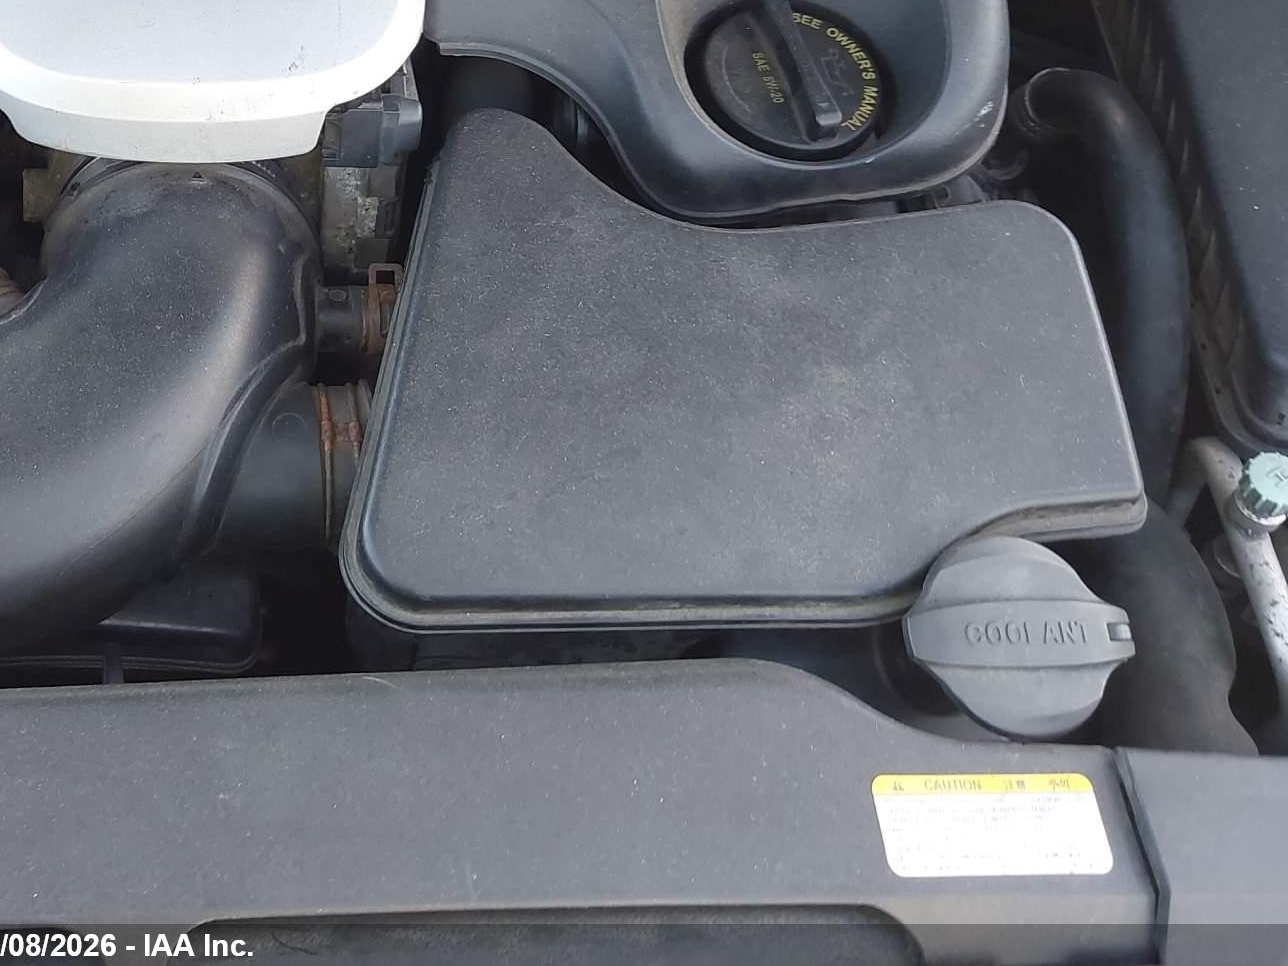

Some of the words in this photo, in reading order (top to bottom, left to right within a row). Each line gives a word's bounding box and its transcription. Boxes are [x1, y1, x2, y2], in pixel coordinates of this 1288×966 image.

[792, 13, 823, 30] SEE
[752, 52, 771, 75] SAE
[825, 27, 877, 81] OWNER'S
[840, 85, 879, 131] MANUAL
[964, 620, 1089, 647] COOLANT
[923, 778, 982, 792] CAUTION
